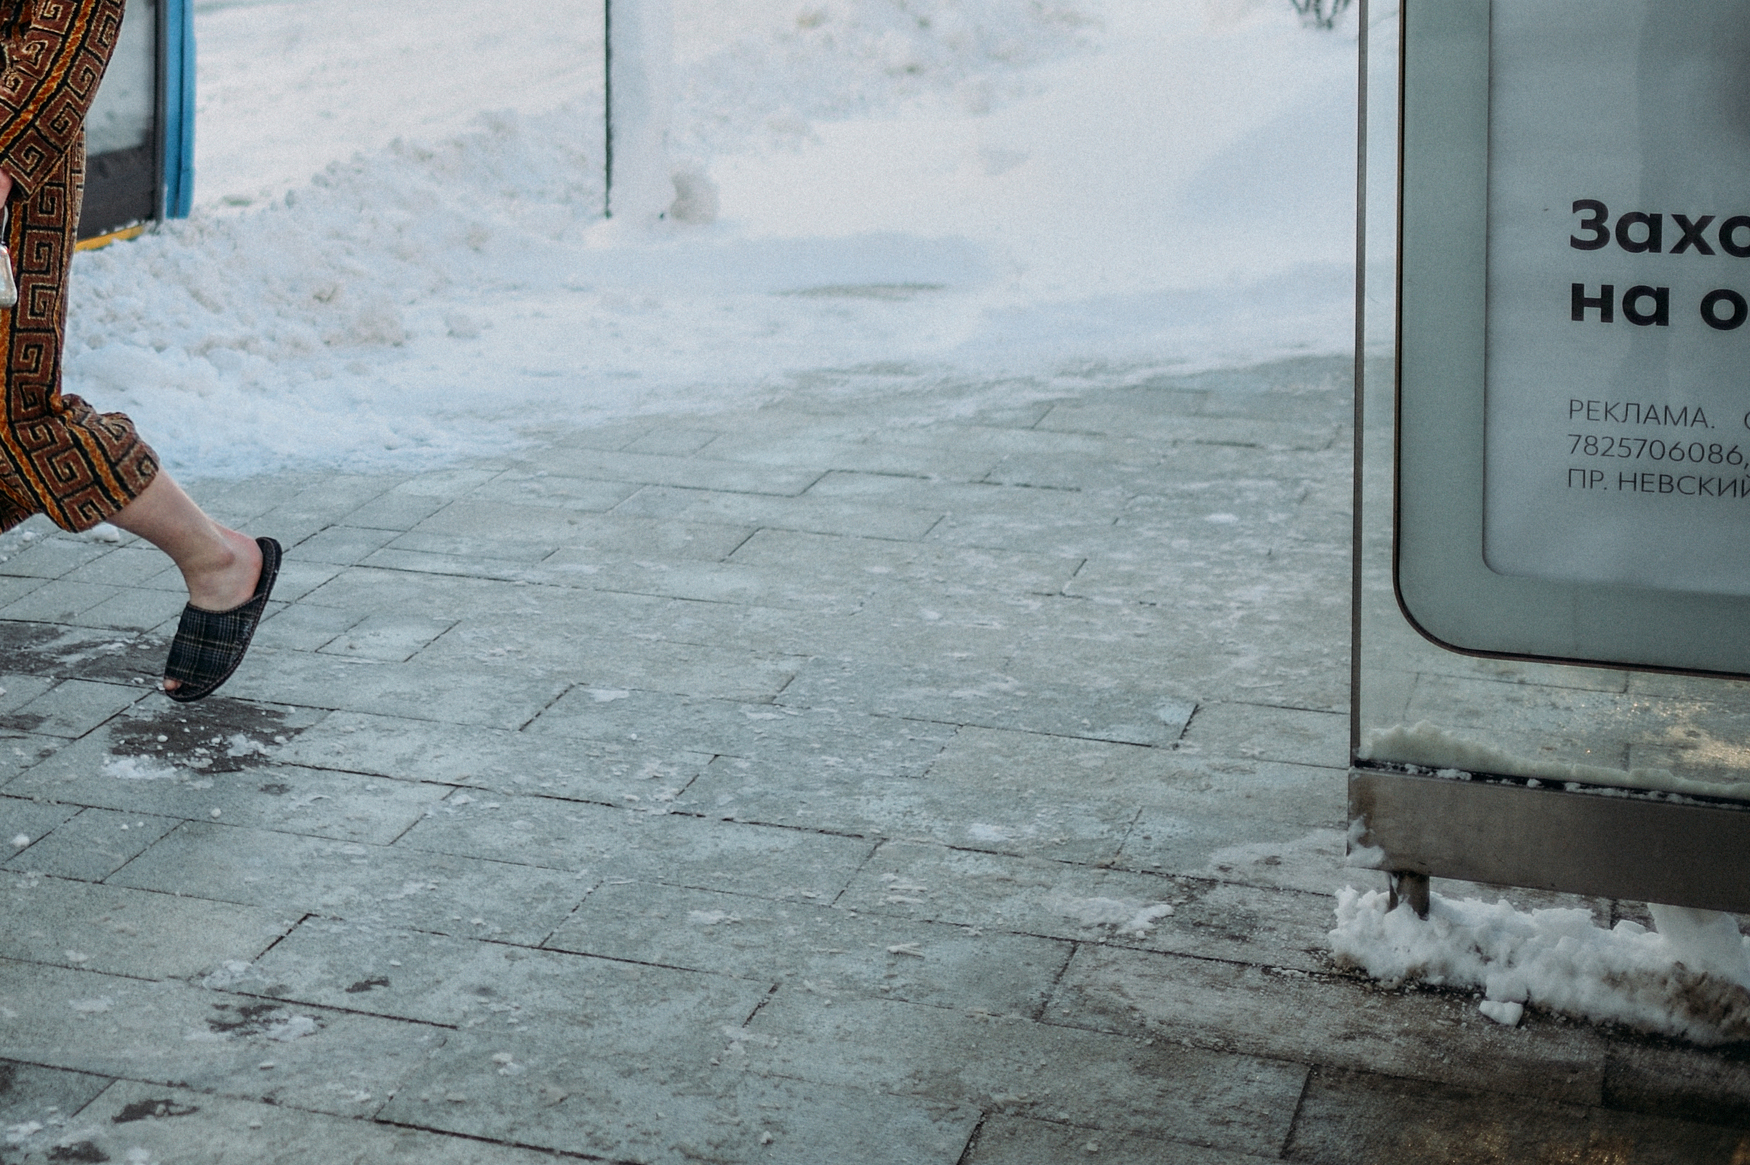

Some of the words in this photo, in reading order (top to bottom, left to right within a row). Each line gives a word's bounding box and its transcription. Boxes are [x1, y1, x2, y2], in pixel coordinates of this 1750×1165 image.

[1570, 199, 1750, 258] Захо
[1571, 282, 1670, 327] на
[1700, 288, 1749, 331] о
[1569, 399, 1715, 429] РЕКЛАМА.
[1568, 433, 1750, 470] 7825706086,
[1568, 468, 1608, 490] ПР.
